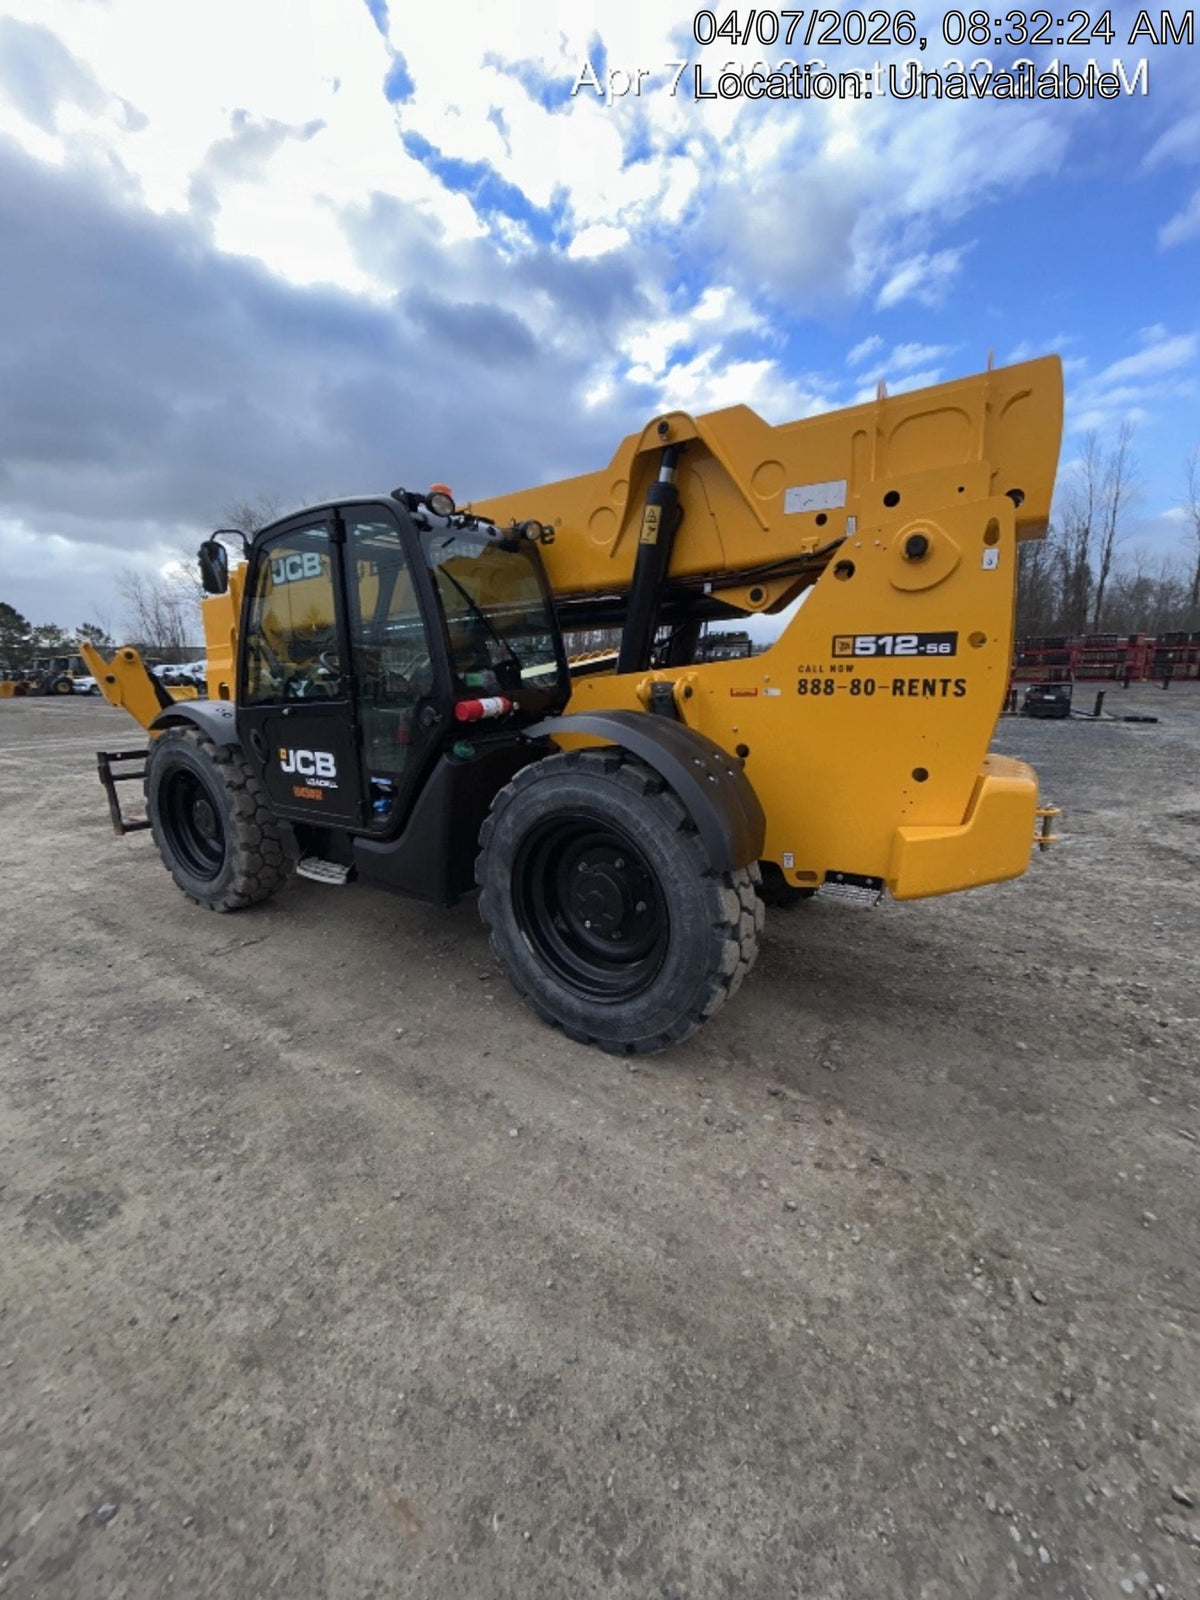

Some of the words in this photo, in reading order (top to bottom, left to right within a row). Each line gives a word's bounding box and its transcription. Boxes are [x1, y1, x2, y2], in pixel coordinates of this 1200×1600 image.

[272, 552, 321, 584] JCB
[854, 635, 952, 656] 512-56
[798, 664, 824, 673] CALL
[830, 664, 854, 674] NOW
[797, 678, 967, 698] 888-80-RENTS
[279, 748, 337, 778] JCB
